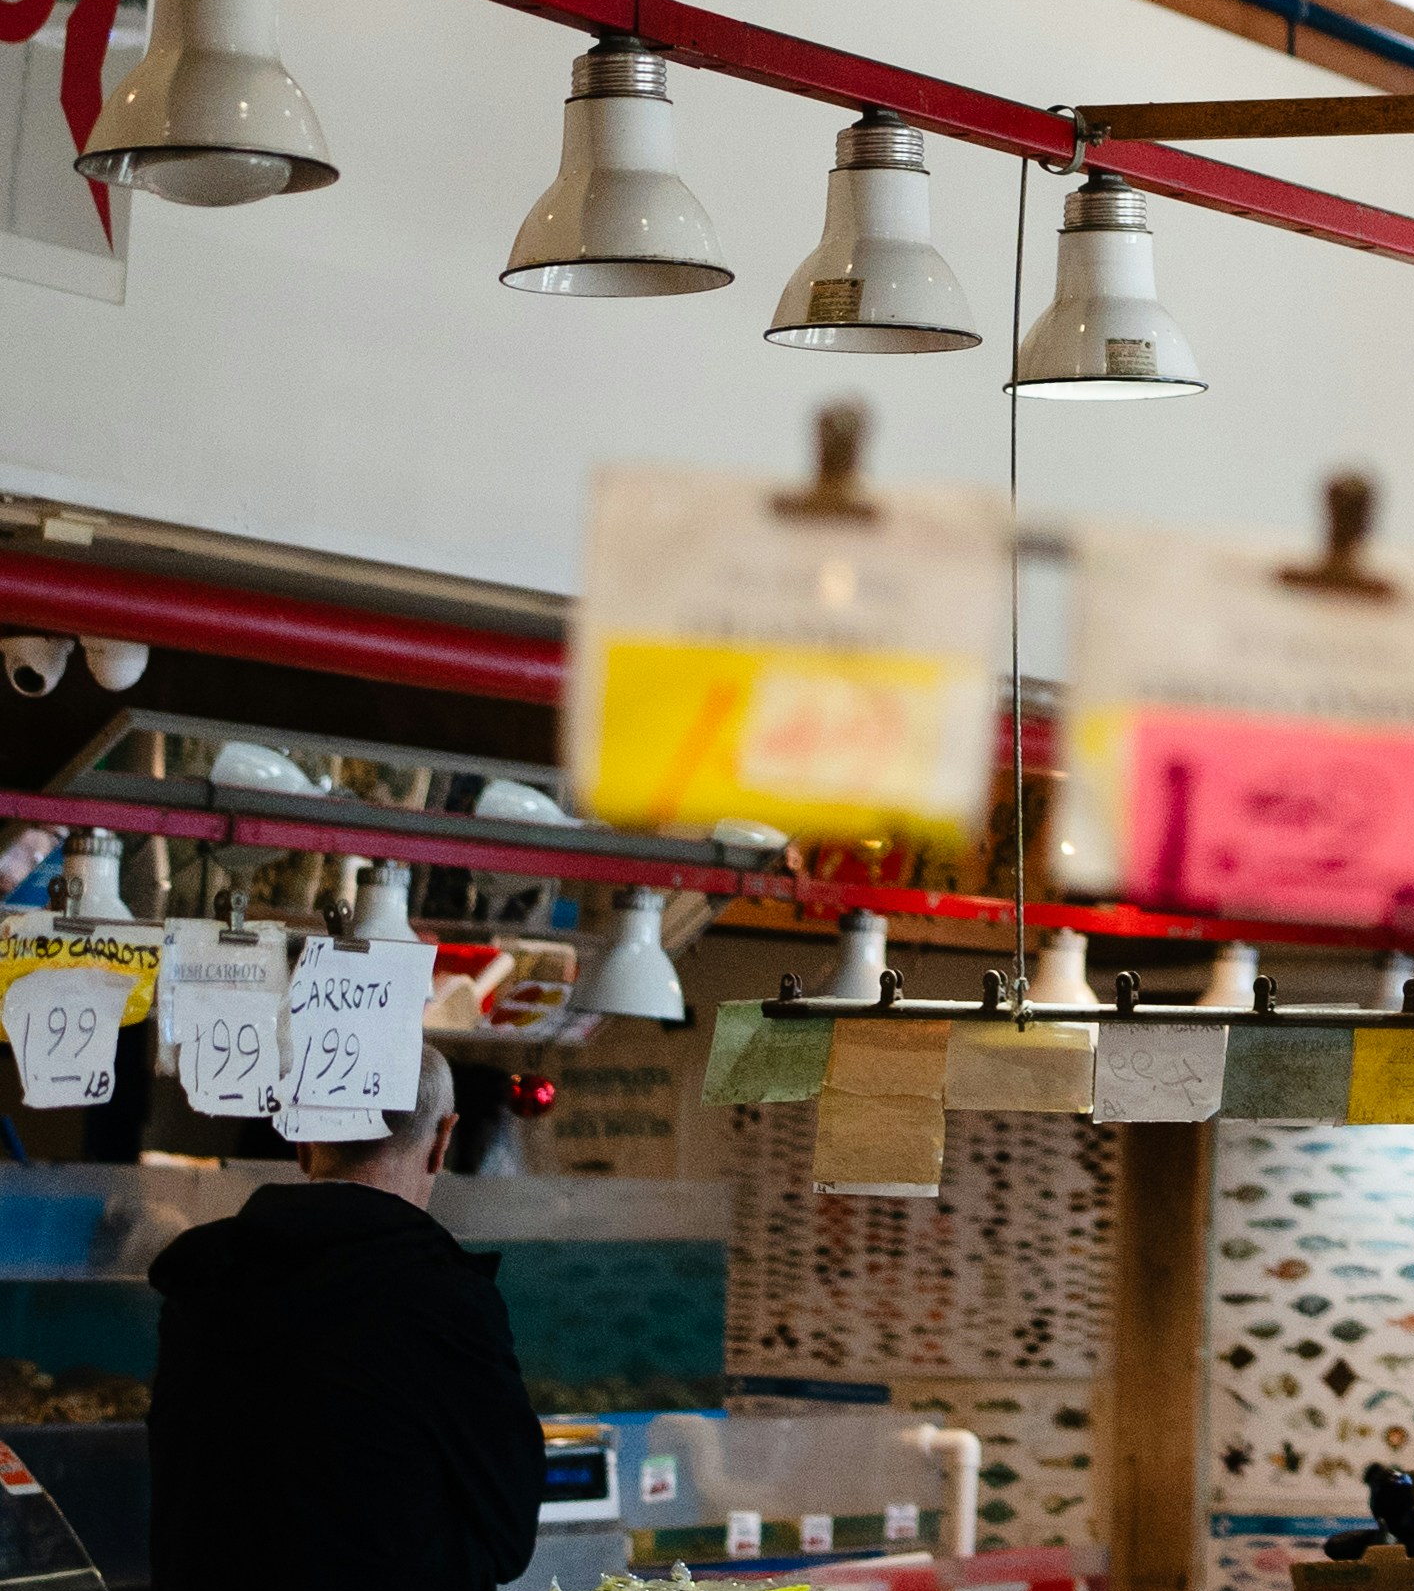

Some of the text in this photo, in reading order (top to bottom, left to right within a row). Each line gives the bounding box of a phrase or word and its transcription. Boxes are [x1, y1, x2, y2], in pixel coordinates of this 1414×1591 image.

[69, 937, 160, 969] CARROTS
[291, 978, 391, 1014] CARROTS
[85, 1071, 111, 1098] LB
[363, 1071, 381, 1095] LB
[258, 1087, 281, 1113] LB
